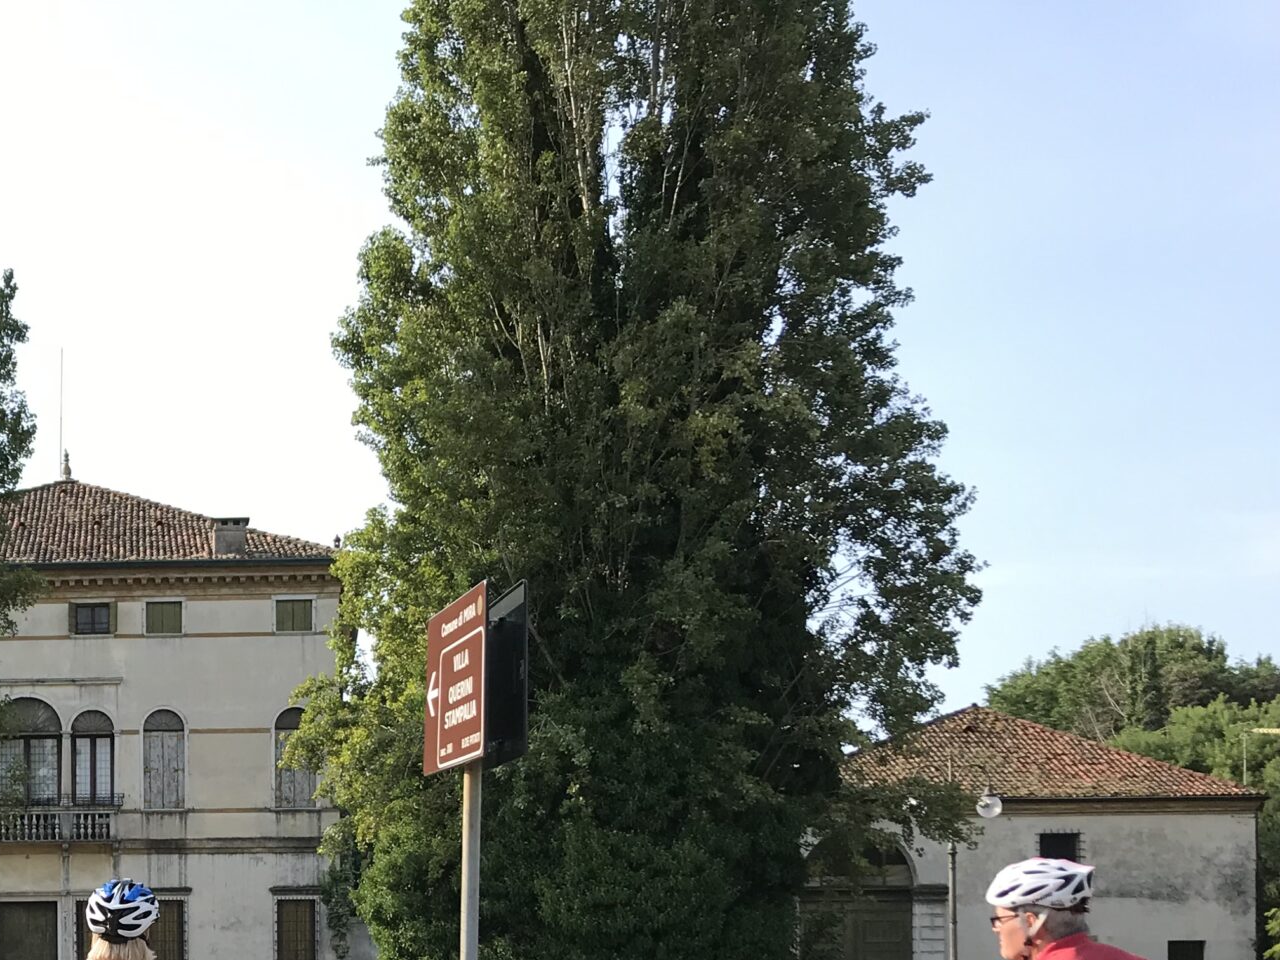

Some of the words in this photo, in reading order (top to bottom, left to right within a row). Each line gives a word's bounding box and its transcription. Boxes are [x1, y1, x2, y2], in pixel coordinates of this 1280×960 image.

[453, 648, 469, 673] VILLA
[448, 675, 473, 704] QUERINI
[444, 699, 477, 729] STAMPALIA
